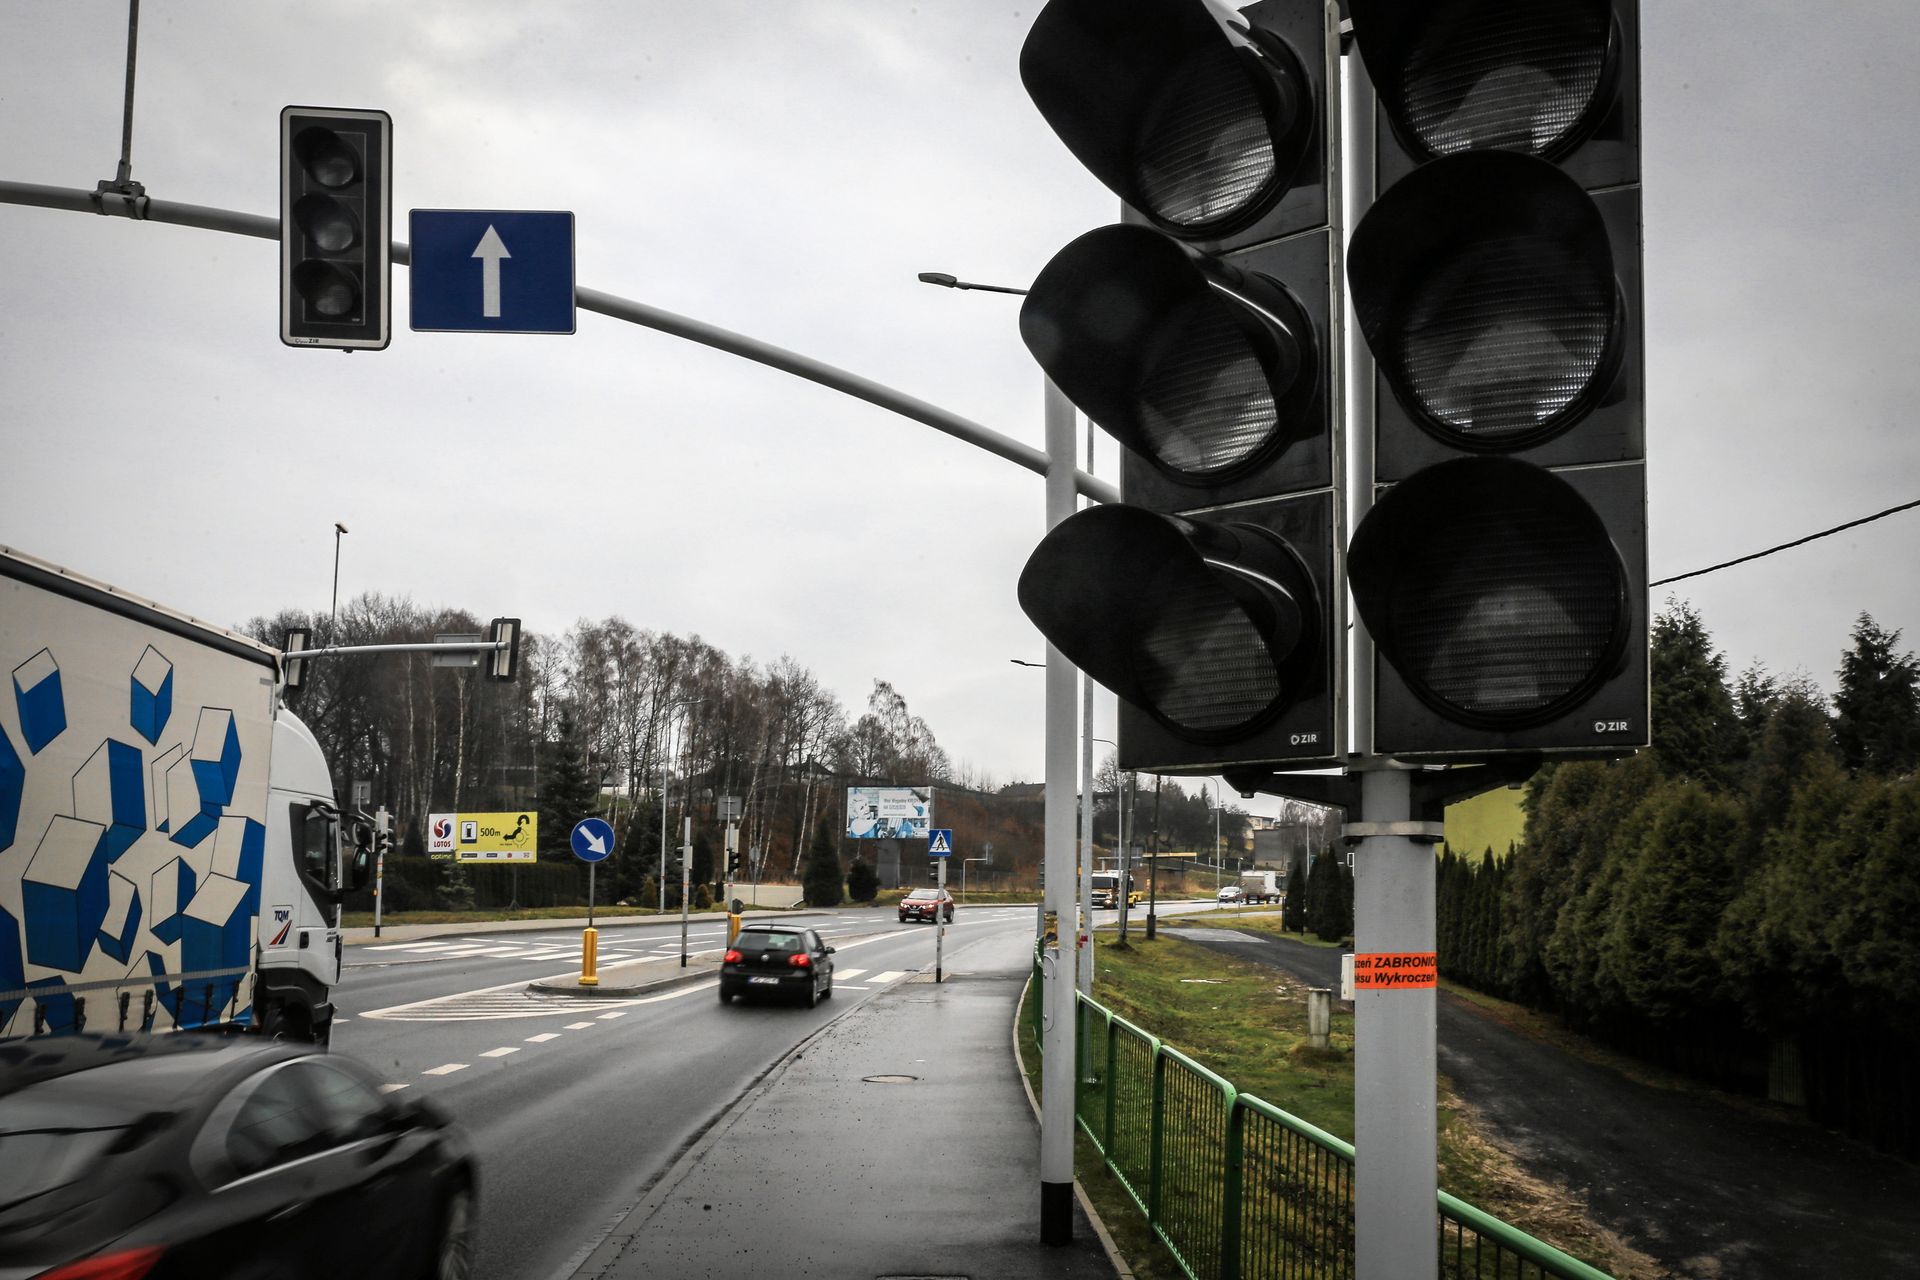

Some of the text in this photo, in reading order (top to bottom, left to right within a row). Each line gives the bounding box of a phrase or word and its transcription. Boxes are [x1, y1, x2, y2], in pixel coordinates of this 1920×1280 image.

[1608, 721, 1628, 731] ZIR
[1300, 734, 1317, 743] ZIR
[480, 827, 500, 837] 500m
[274, 910, 290, 923] TQM
